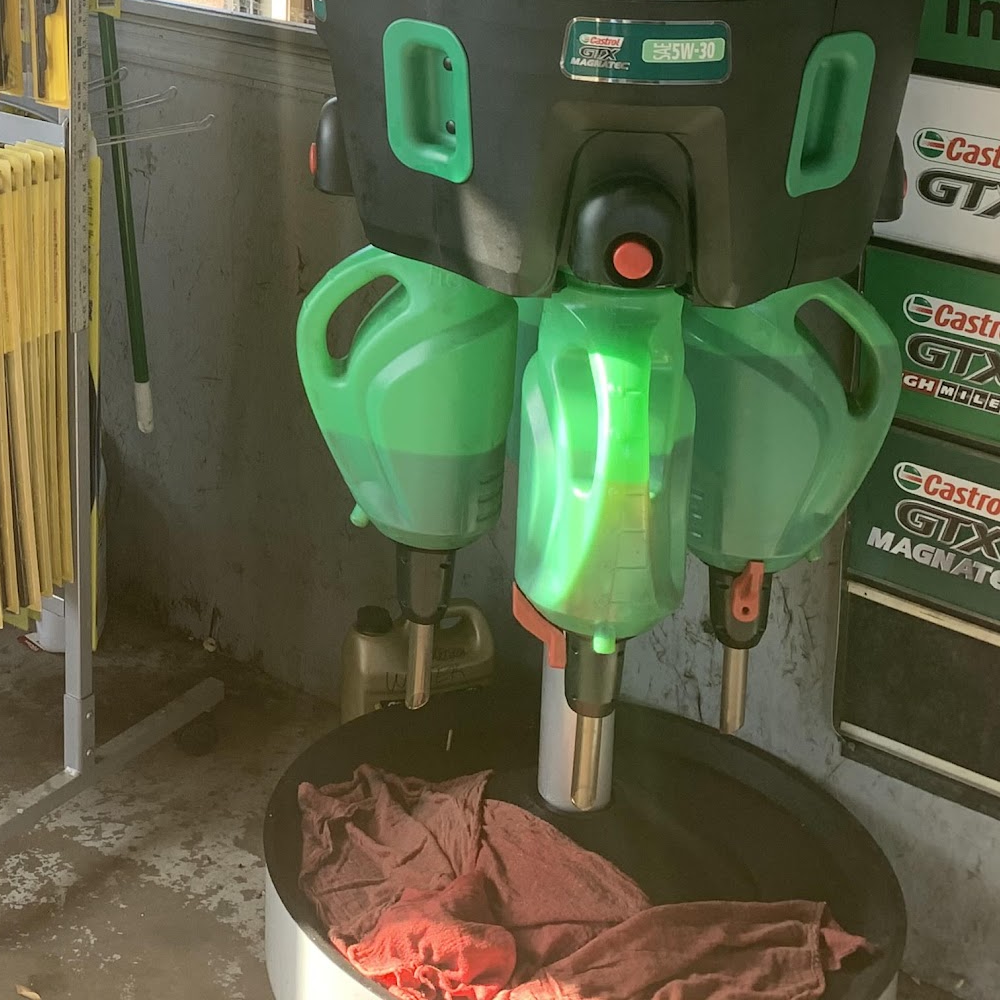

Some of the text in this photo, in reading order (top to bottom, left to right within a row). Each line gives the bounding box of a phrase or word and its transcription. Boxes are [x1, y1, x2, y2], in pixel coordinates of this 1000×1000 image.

[590, 36, 621, 46] Castrol
[578, 46, 621, 61] GTX
[652, 42, 716, 60] SAE 5W-30
[570, 56, 630, 71] MAGNATEC
[895, 498, 1000, 563] GTX
